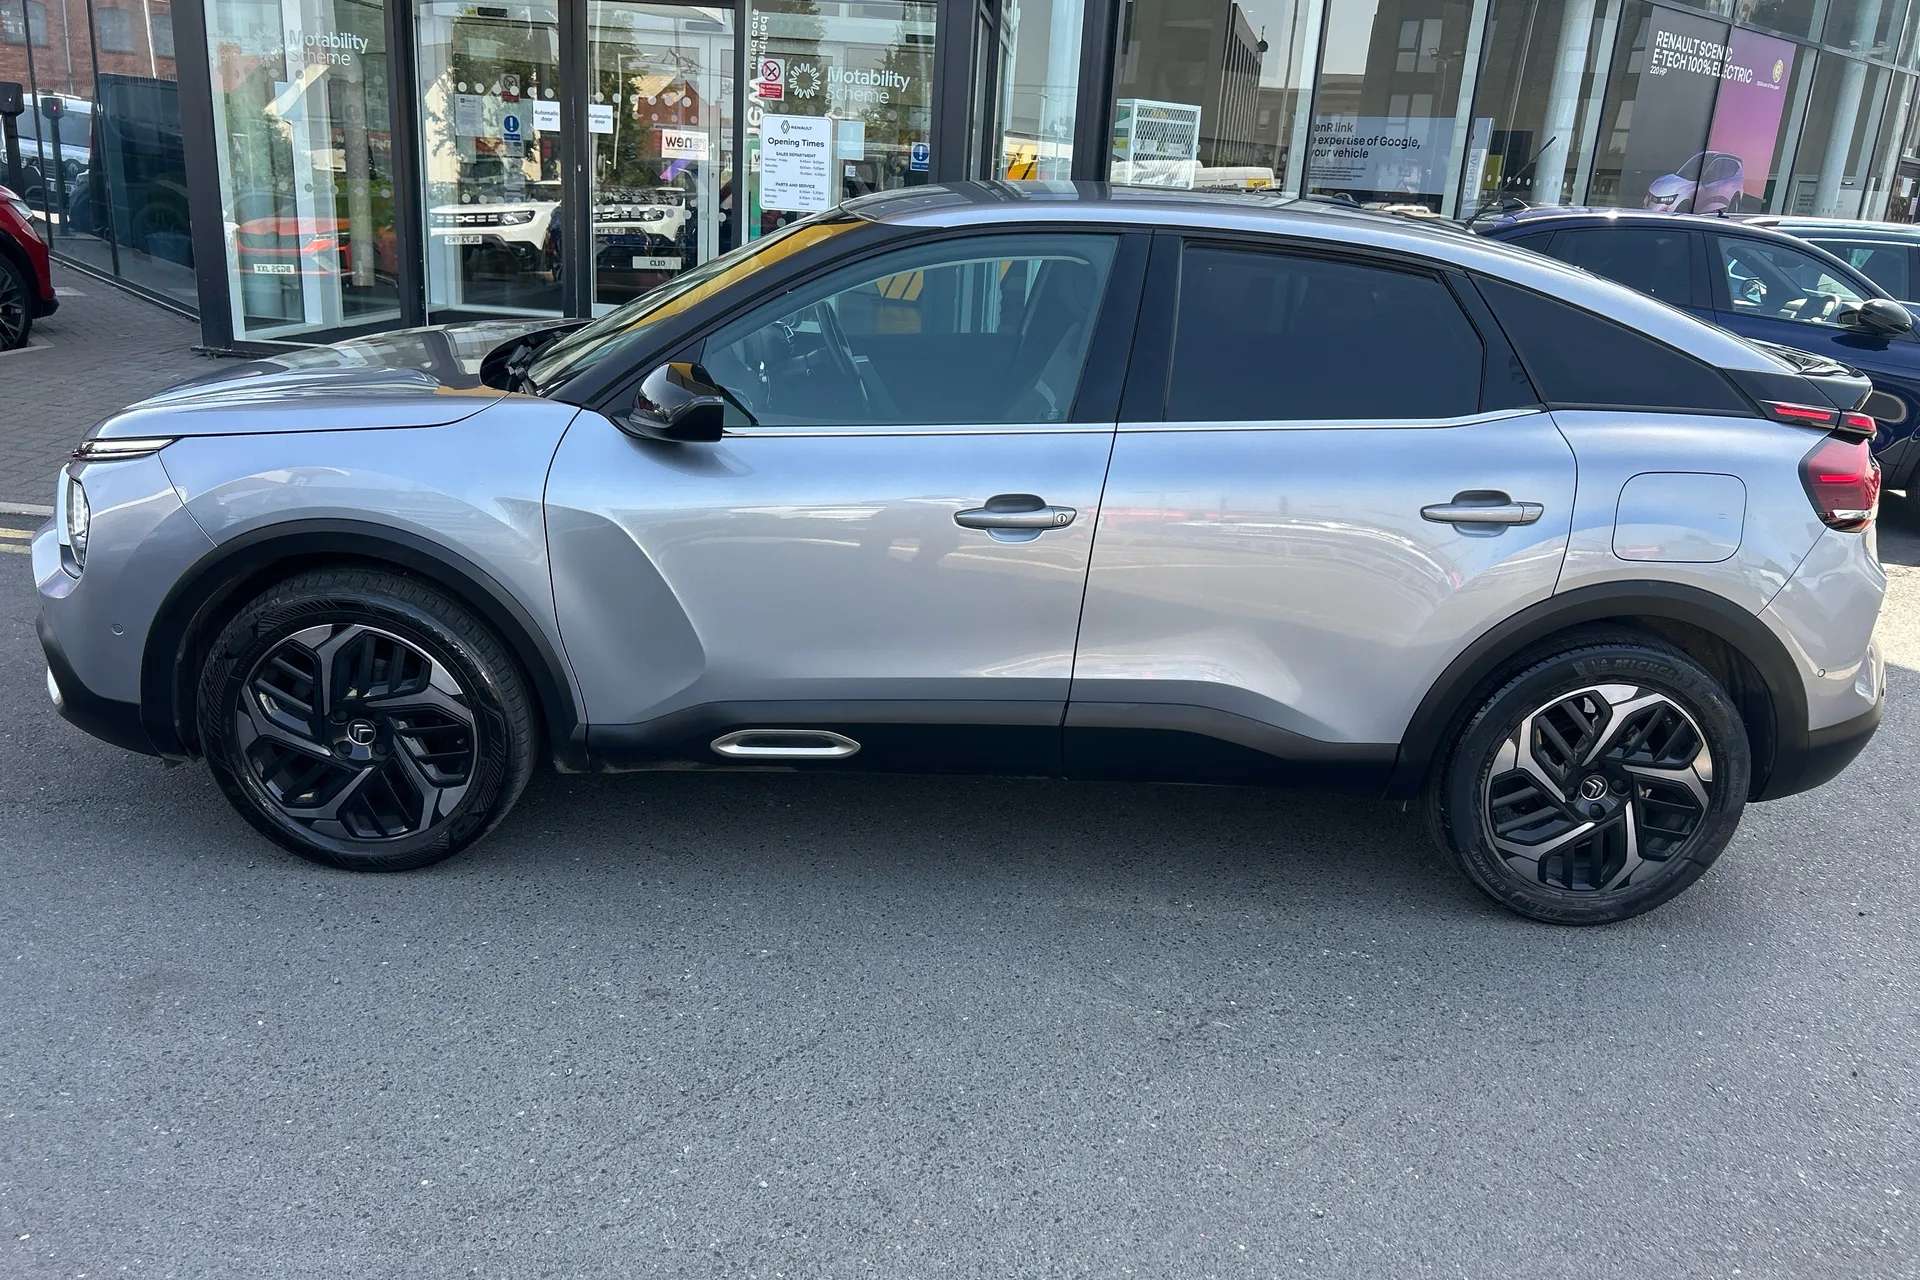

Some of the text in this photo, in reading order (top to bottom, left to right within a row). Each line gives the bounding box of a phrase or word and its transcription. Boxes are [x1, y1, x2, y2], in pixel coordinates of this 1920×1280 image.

[289, 30, 369, 54] Motability
[1656, 31, 1700, 54] RENAULT
[288, 48, 351, 66] Scheme
[1652, 48, 1688, 70] E-TECH
[1688, 55, 1711, 76] 100%
[827, 66, 910, 93] Motability
[826, 83, 890, 104] Scheme
[1313, 122, 1333, 133] enR
[768, 137, 825, 148] Opening Times
[1318, 136, 1365, 147] expertise
[1367, 137, 1379, 146] of
[1380, 137, 1421, 150] Google,
[1333, 148, 1369, 160] vehicle
